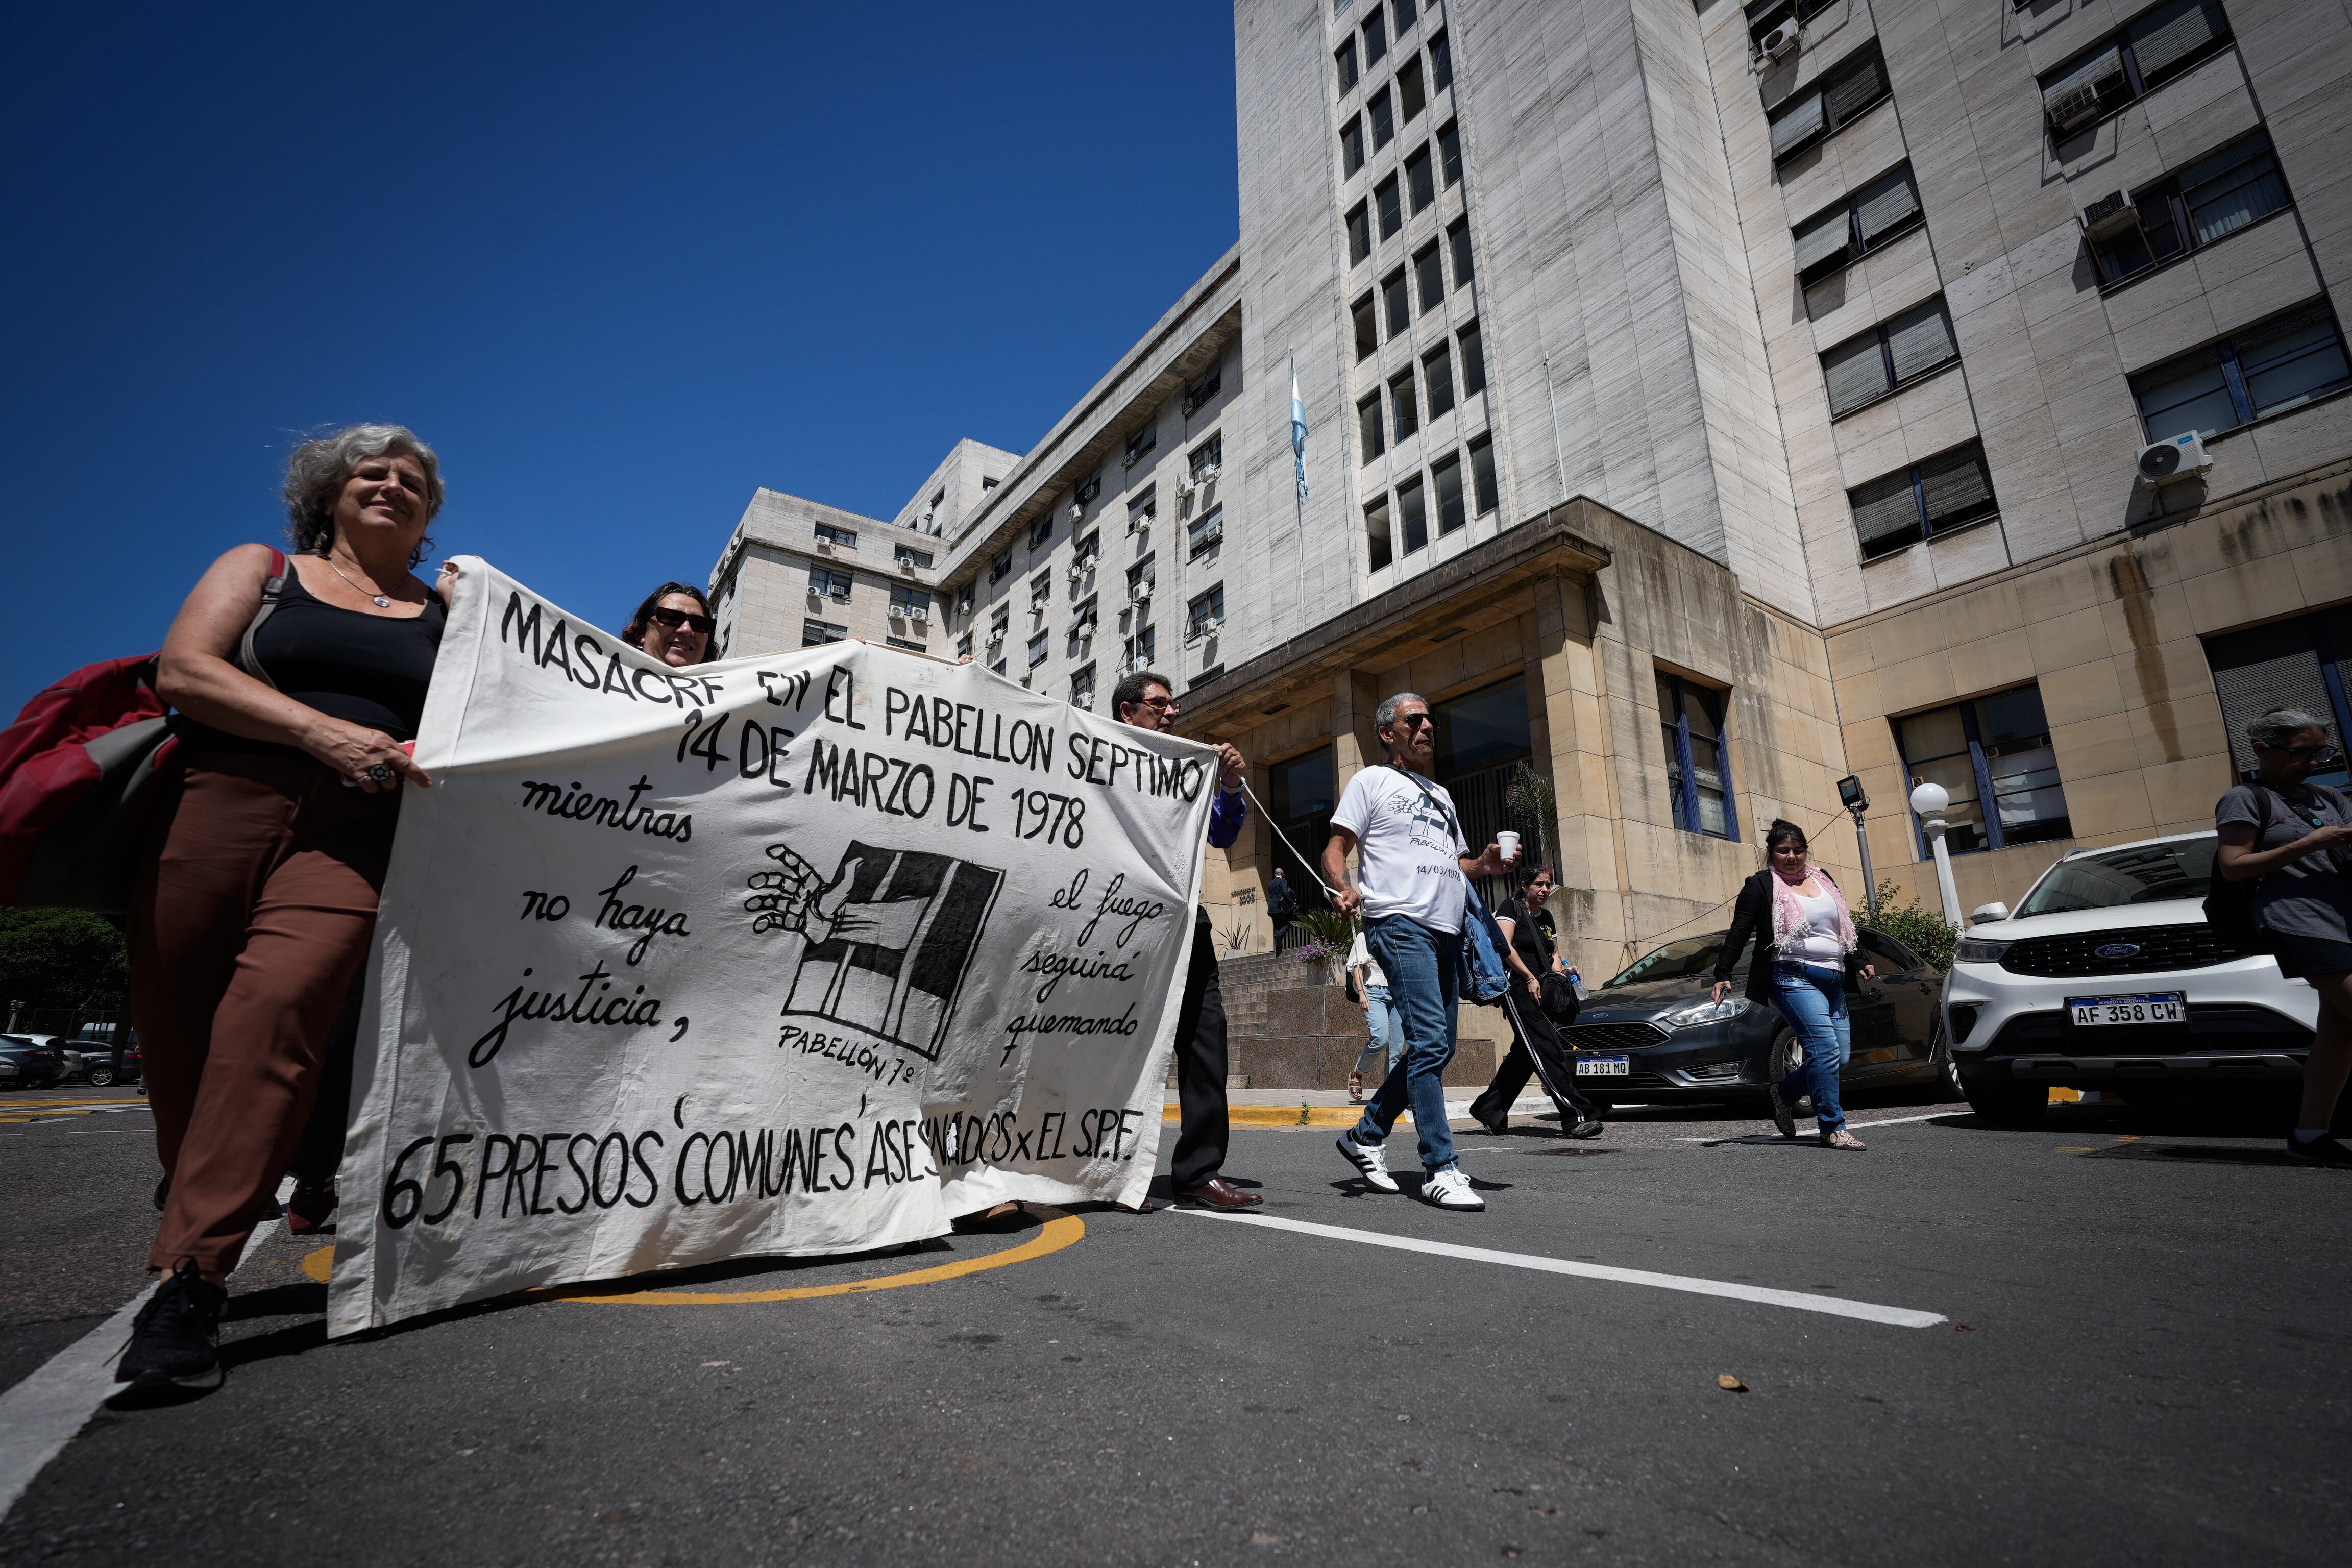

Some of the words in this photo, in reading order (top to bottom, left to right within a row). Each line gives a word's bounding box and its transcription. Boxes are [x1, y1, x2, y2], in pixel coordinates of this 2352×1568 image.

[756, 670, 811, 712] EN
[824, 665, 865, 730] EL
[886, 686, 1055, 773] PABELLON
[1068, 732, 1204, 803] SEPTIMO
[522, 774, 692, 843] mientras
[739, 719, 795, 788] DE
[804, 738, 935, 819] MARZO
[946, 772, 994, 832] DE
[1011, 787, 1086, 849] 1978
[1410, 838, 1447, 855] PABELLÓN
[1416, 865, 1461, 881] 14/03/1978
[521, 891, 570, 922] no
[595, 865, 691, 966] haya
[1048, 868, 1090, 911] el
[1077, 872, 1165, 947] fuego
[1021, 951, 1142, 1004] seguirá
[2104, 946, 2128, 955] Ford
[467, 960, 690, 1069] justicia,
[1000, 1002, 1140, 1068] quemando
[2078, 1007, 2100, 1023] AF
[2106, 1004, 2145, 1021] 358
[2151, 1002, 2177, 1020] CW
[778, 1024, 886, 1081] PABELLÓN
[1579, 1063, 1590, 1074] AB
[1593, 1063, 1610, 1074] 181
[1614, 1062, 1626, 1074] MQ
[383, 1134, 474, 1230] 65
[473, 1130, 664, 1220] PRESOS
[1035, 1111, 1066, 1162] EL
[1073, 1108, 1144, 1161] S.P.F.
